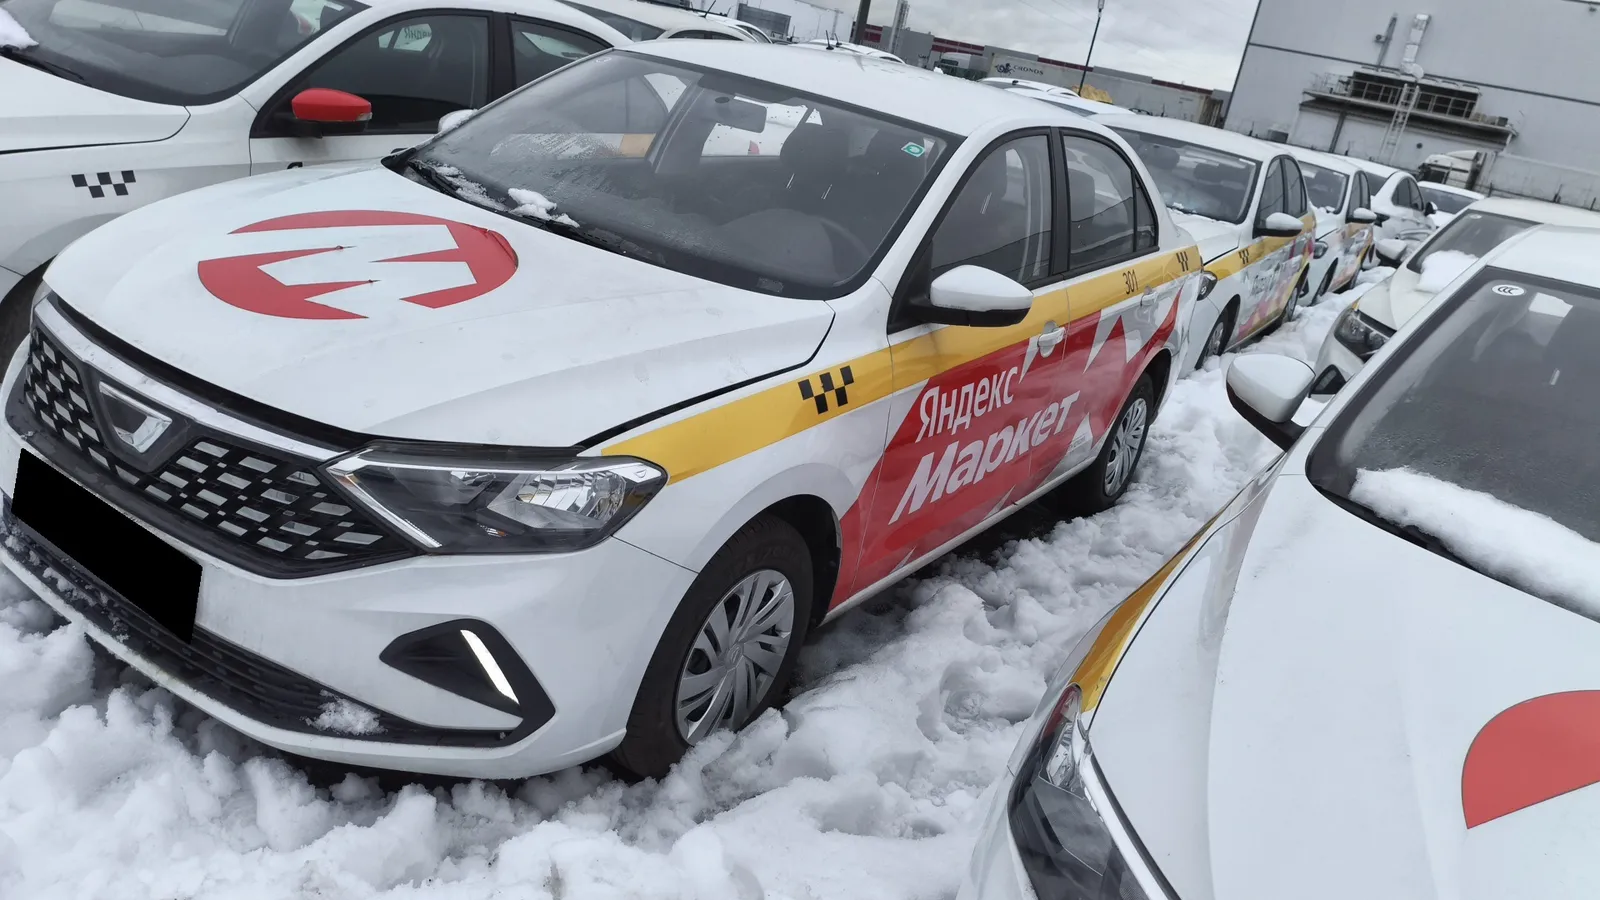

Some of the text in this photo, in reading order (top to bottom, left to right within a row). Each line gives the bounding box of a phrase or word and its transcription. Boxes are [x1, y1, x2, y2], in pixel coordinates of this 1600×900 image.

[1013, 64, 1044, 76] CRONOS
[1122, 269, 1139, 295] 301
[915, 367, 1018, 443] Яндекс
[888, 390, 1081, 525] Маркет
